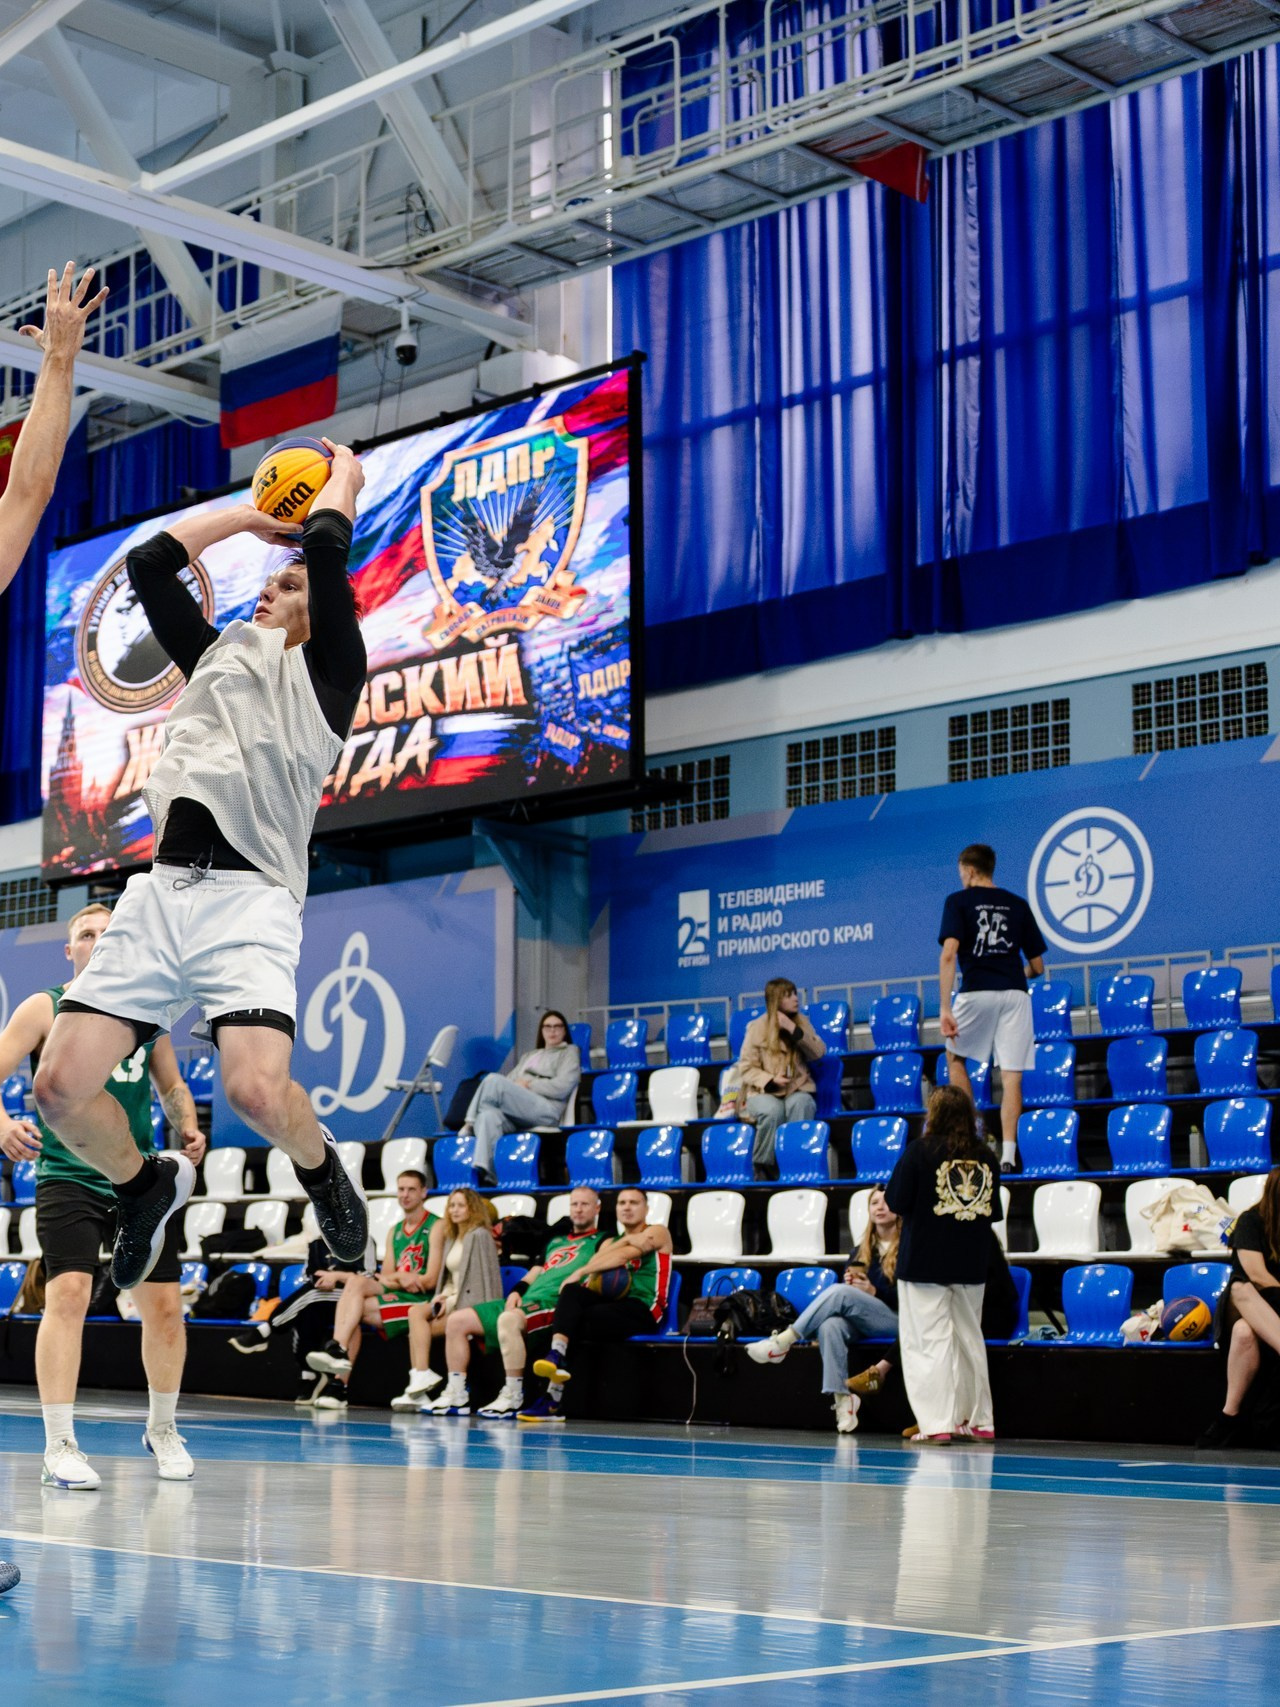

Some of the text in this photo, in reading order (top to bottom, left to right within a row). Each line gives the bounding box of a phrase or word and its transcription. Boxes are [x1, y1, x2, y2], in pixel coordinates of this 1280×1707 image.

[451, 436, 556, 502] ЛДПР
[577, 658, 631, 700] ЛДПР
[718, 879, 825, 910] ТЕЛЕВИДЕНИЕ
[718, 909, 783, 933] И РАДИО
[717, 922, 874, 958] ПРИМОРСКОГО КРАЯ
[678, 954, 710, 968] РЕГИОН
